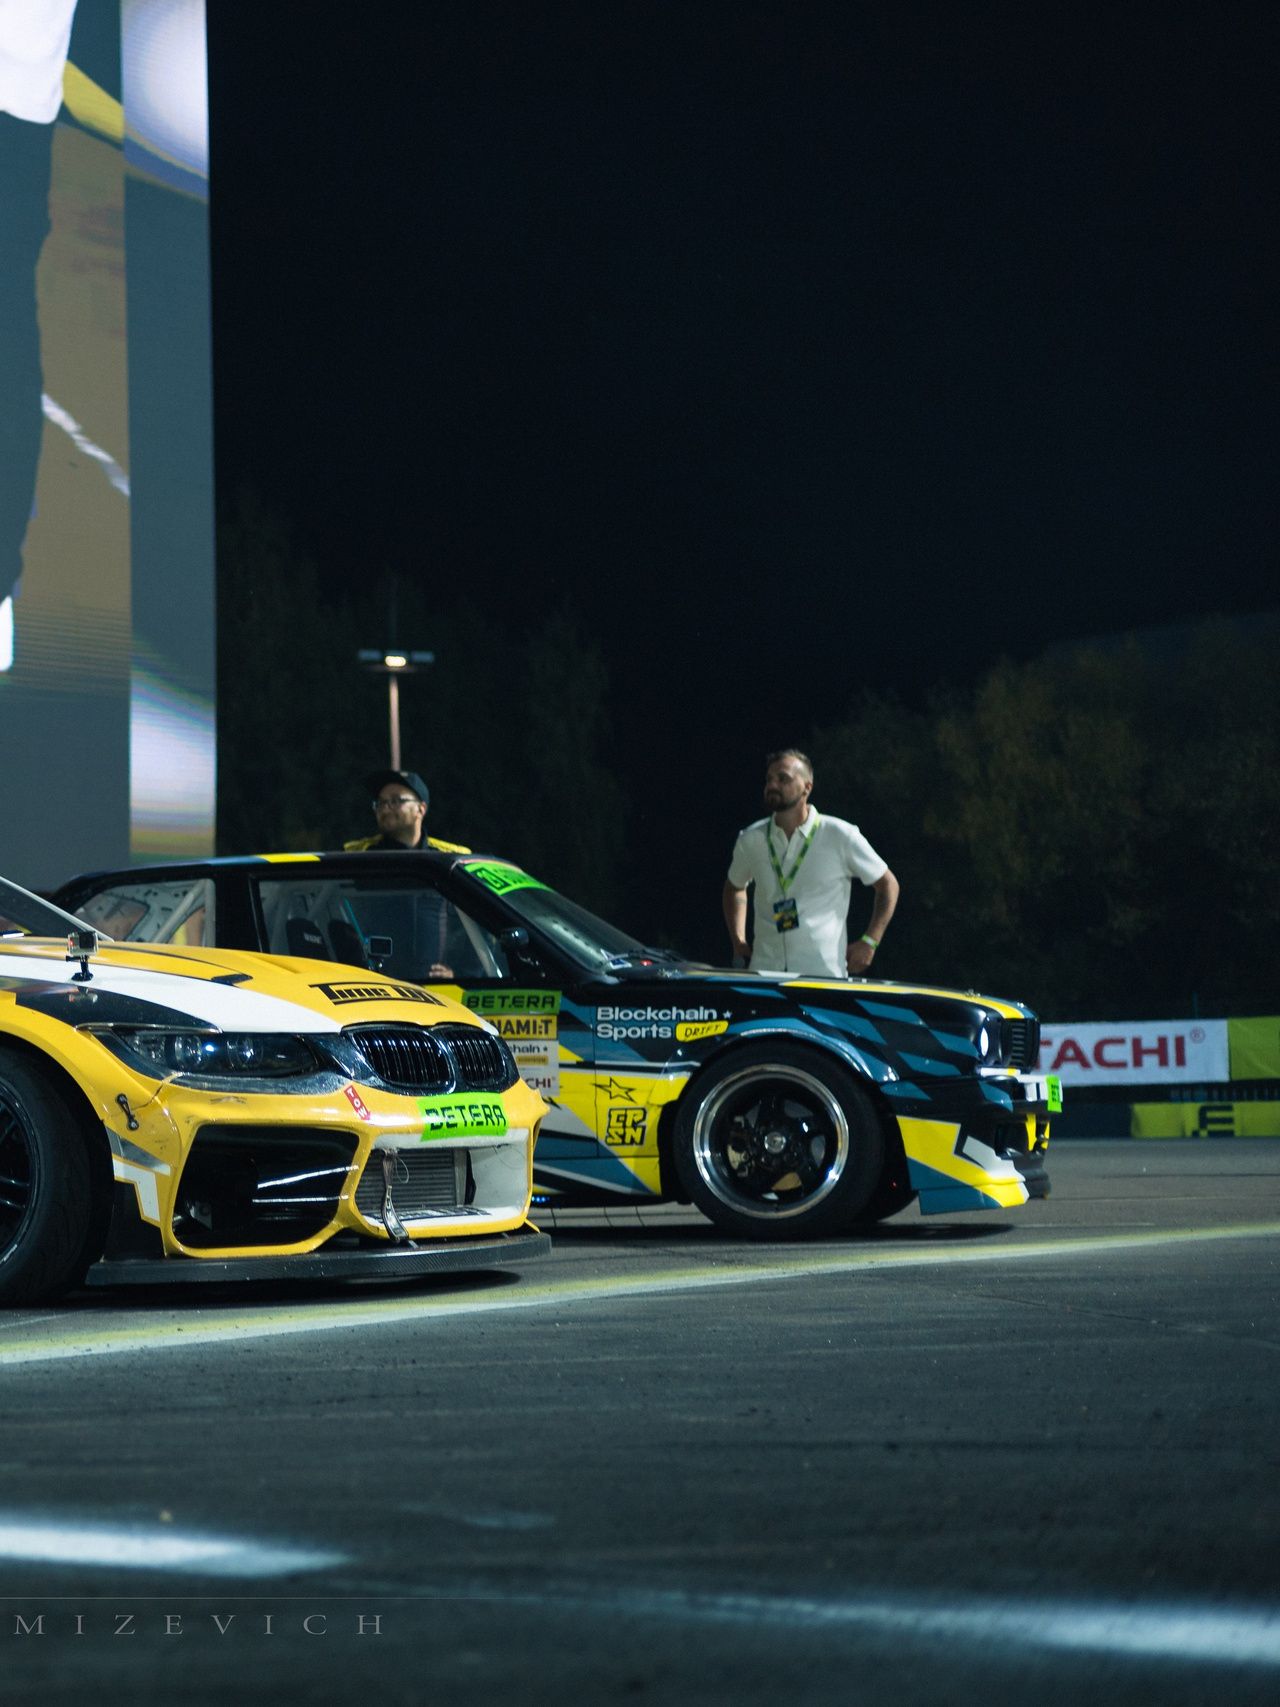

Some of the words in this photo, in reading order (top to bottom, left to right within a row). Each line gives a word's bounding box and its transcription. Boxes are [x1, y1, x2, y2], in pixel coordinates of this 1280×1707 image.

[596, 1006, 718, 1021] Blockchain
[487, 1019, 552, 1035] NAMI:T
[596, 1023, 672, 1041] Sports
[684, 1024, 721, 1038] DRIFT
[346, 1088, 368, 1118] TOW
